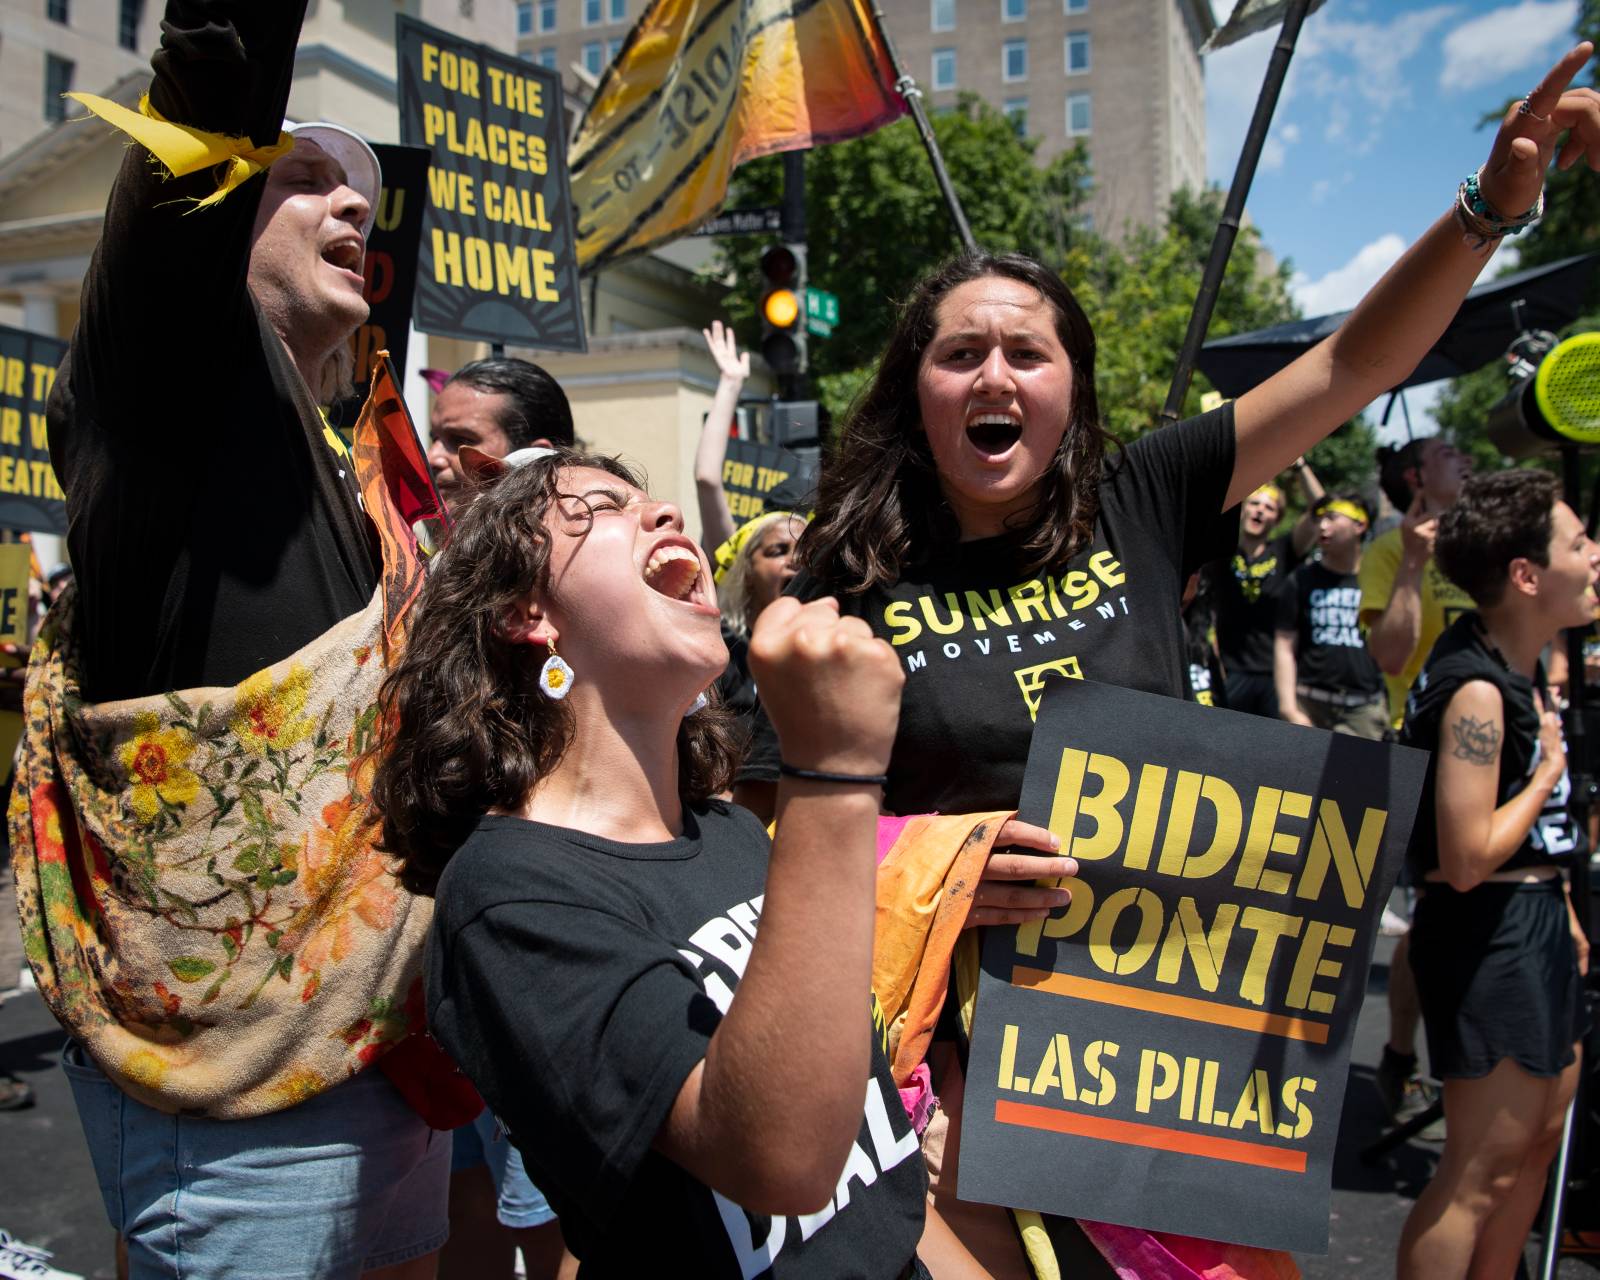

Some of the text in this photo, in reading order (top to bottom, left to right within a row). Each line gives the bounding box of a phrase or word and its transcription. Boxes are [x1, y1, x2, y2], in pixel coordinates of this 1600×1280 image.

[421, 42, 544, 118] FOR THE
[423, 103, 548, 175] PLACES
[427, 166, 476, 216] WE
[483, 180, 552, 232] CALL
[431, 228, 559, 302] HOME
[0, 456, 66, 500] EATH
[723, 459, 755, 489] FOR
[883, 550, 1126, 646] SUNRISE
[906, 596, 1129, 673] MOVEMENT
[1311, 608, 1359, 627] NEW
[1312, 627, 1365, 648] DEAL
[1048, 747, 1388, 909] BIDEN
[1015, 876, 1356, 1015] PONTE
[997, 1024, 1318, 1140] LAS PILAS
